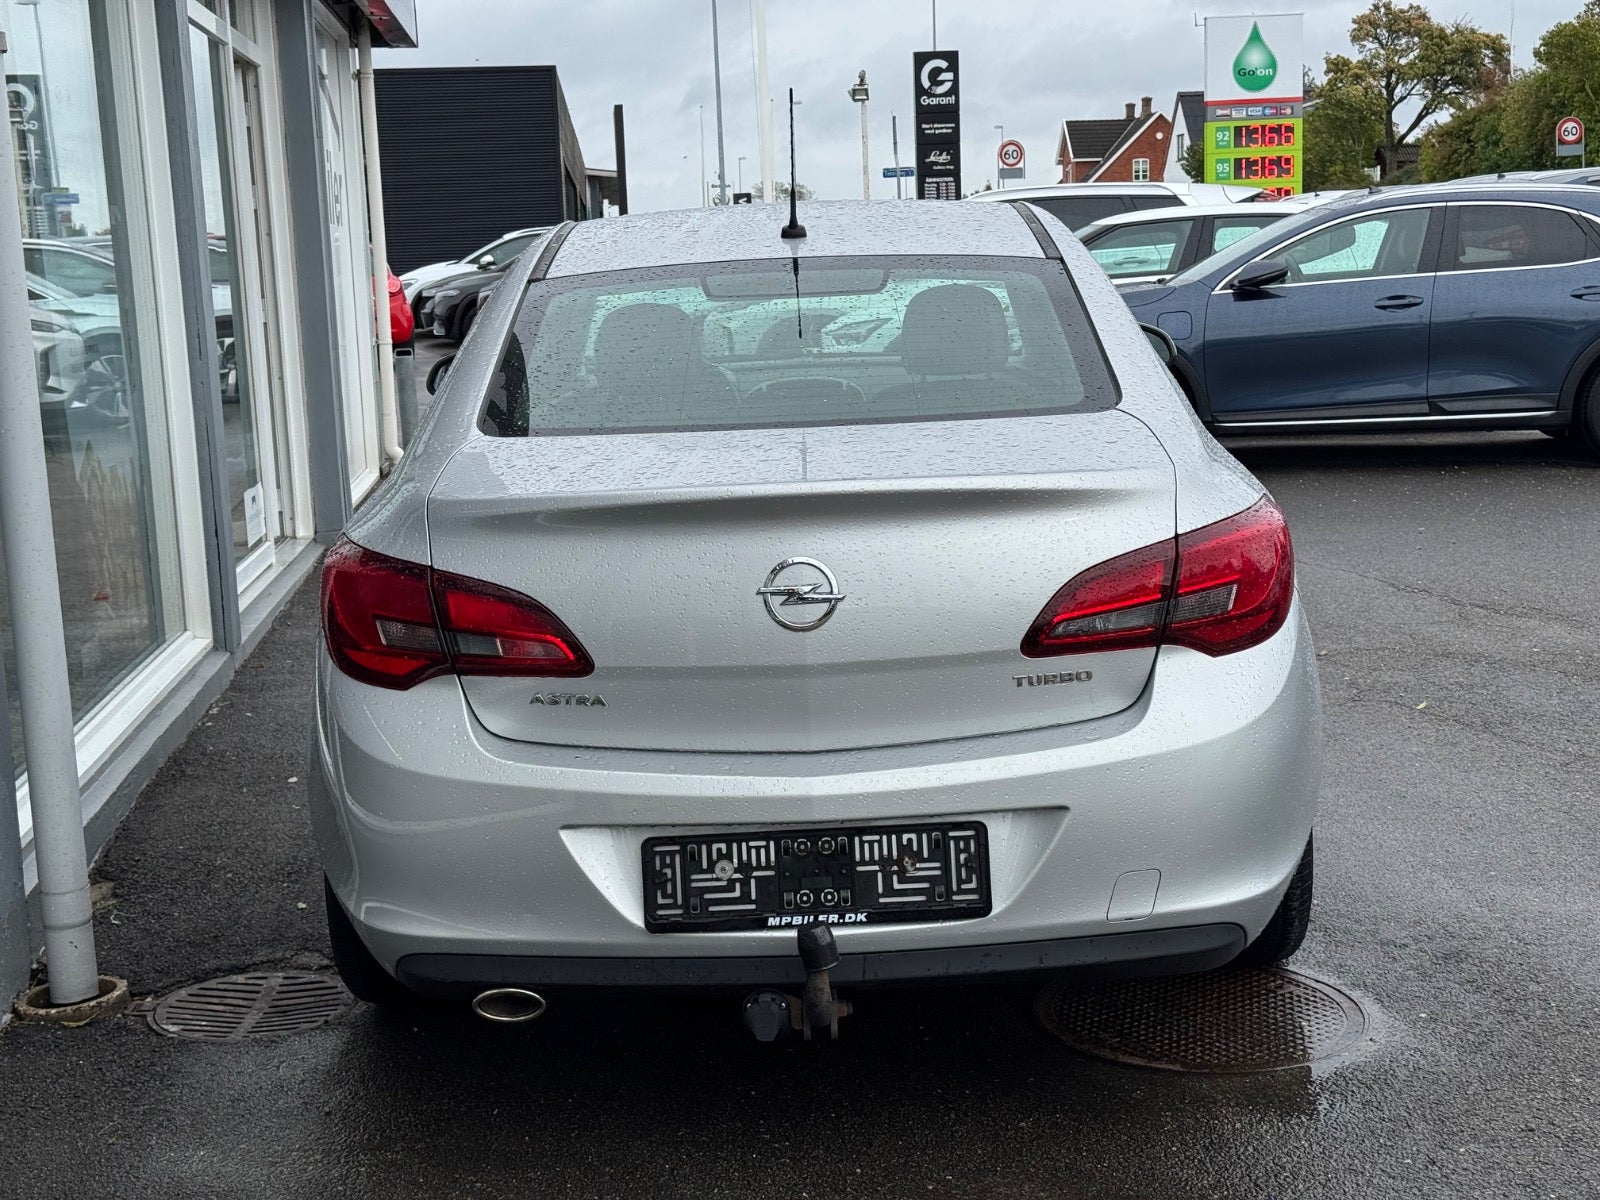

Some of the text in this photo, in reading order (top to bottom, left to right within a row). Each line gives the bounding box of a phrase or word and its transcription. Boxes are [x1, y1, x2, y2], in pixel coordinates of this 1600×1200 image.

[920, 94, 955, 105] Garant
[1216, 131, 1230, 141] 92
[1562, 126, 1578, 137] 60
[1003, 149, 1018, 160] 60
[1216, 163, 1230, 173] 95
[1012, 669, 1093, 688] TURBO
[529, 692, 609, 707] ASTRA
